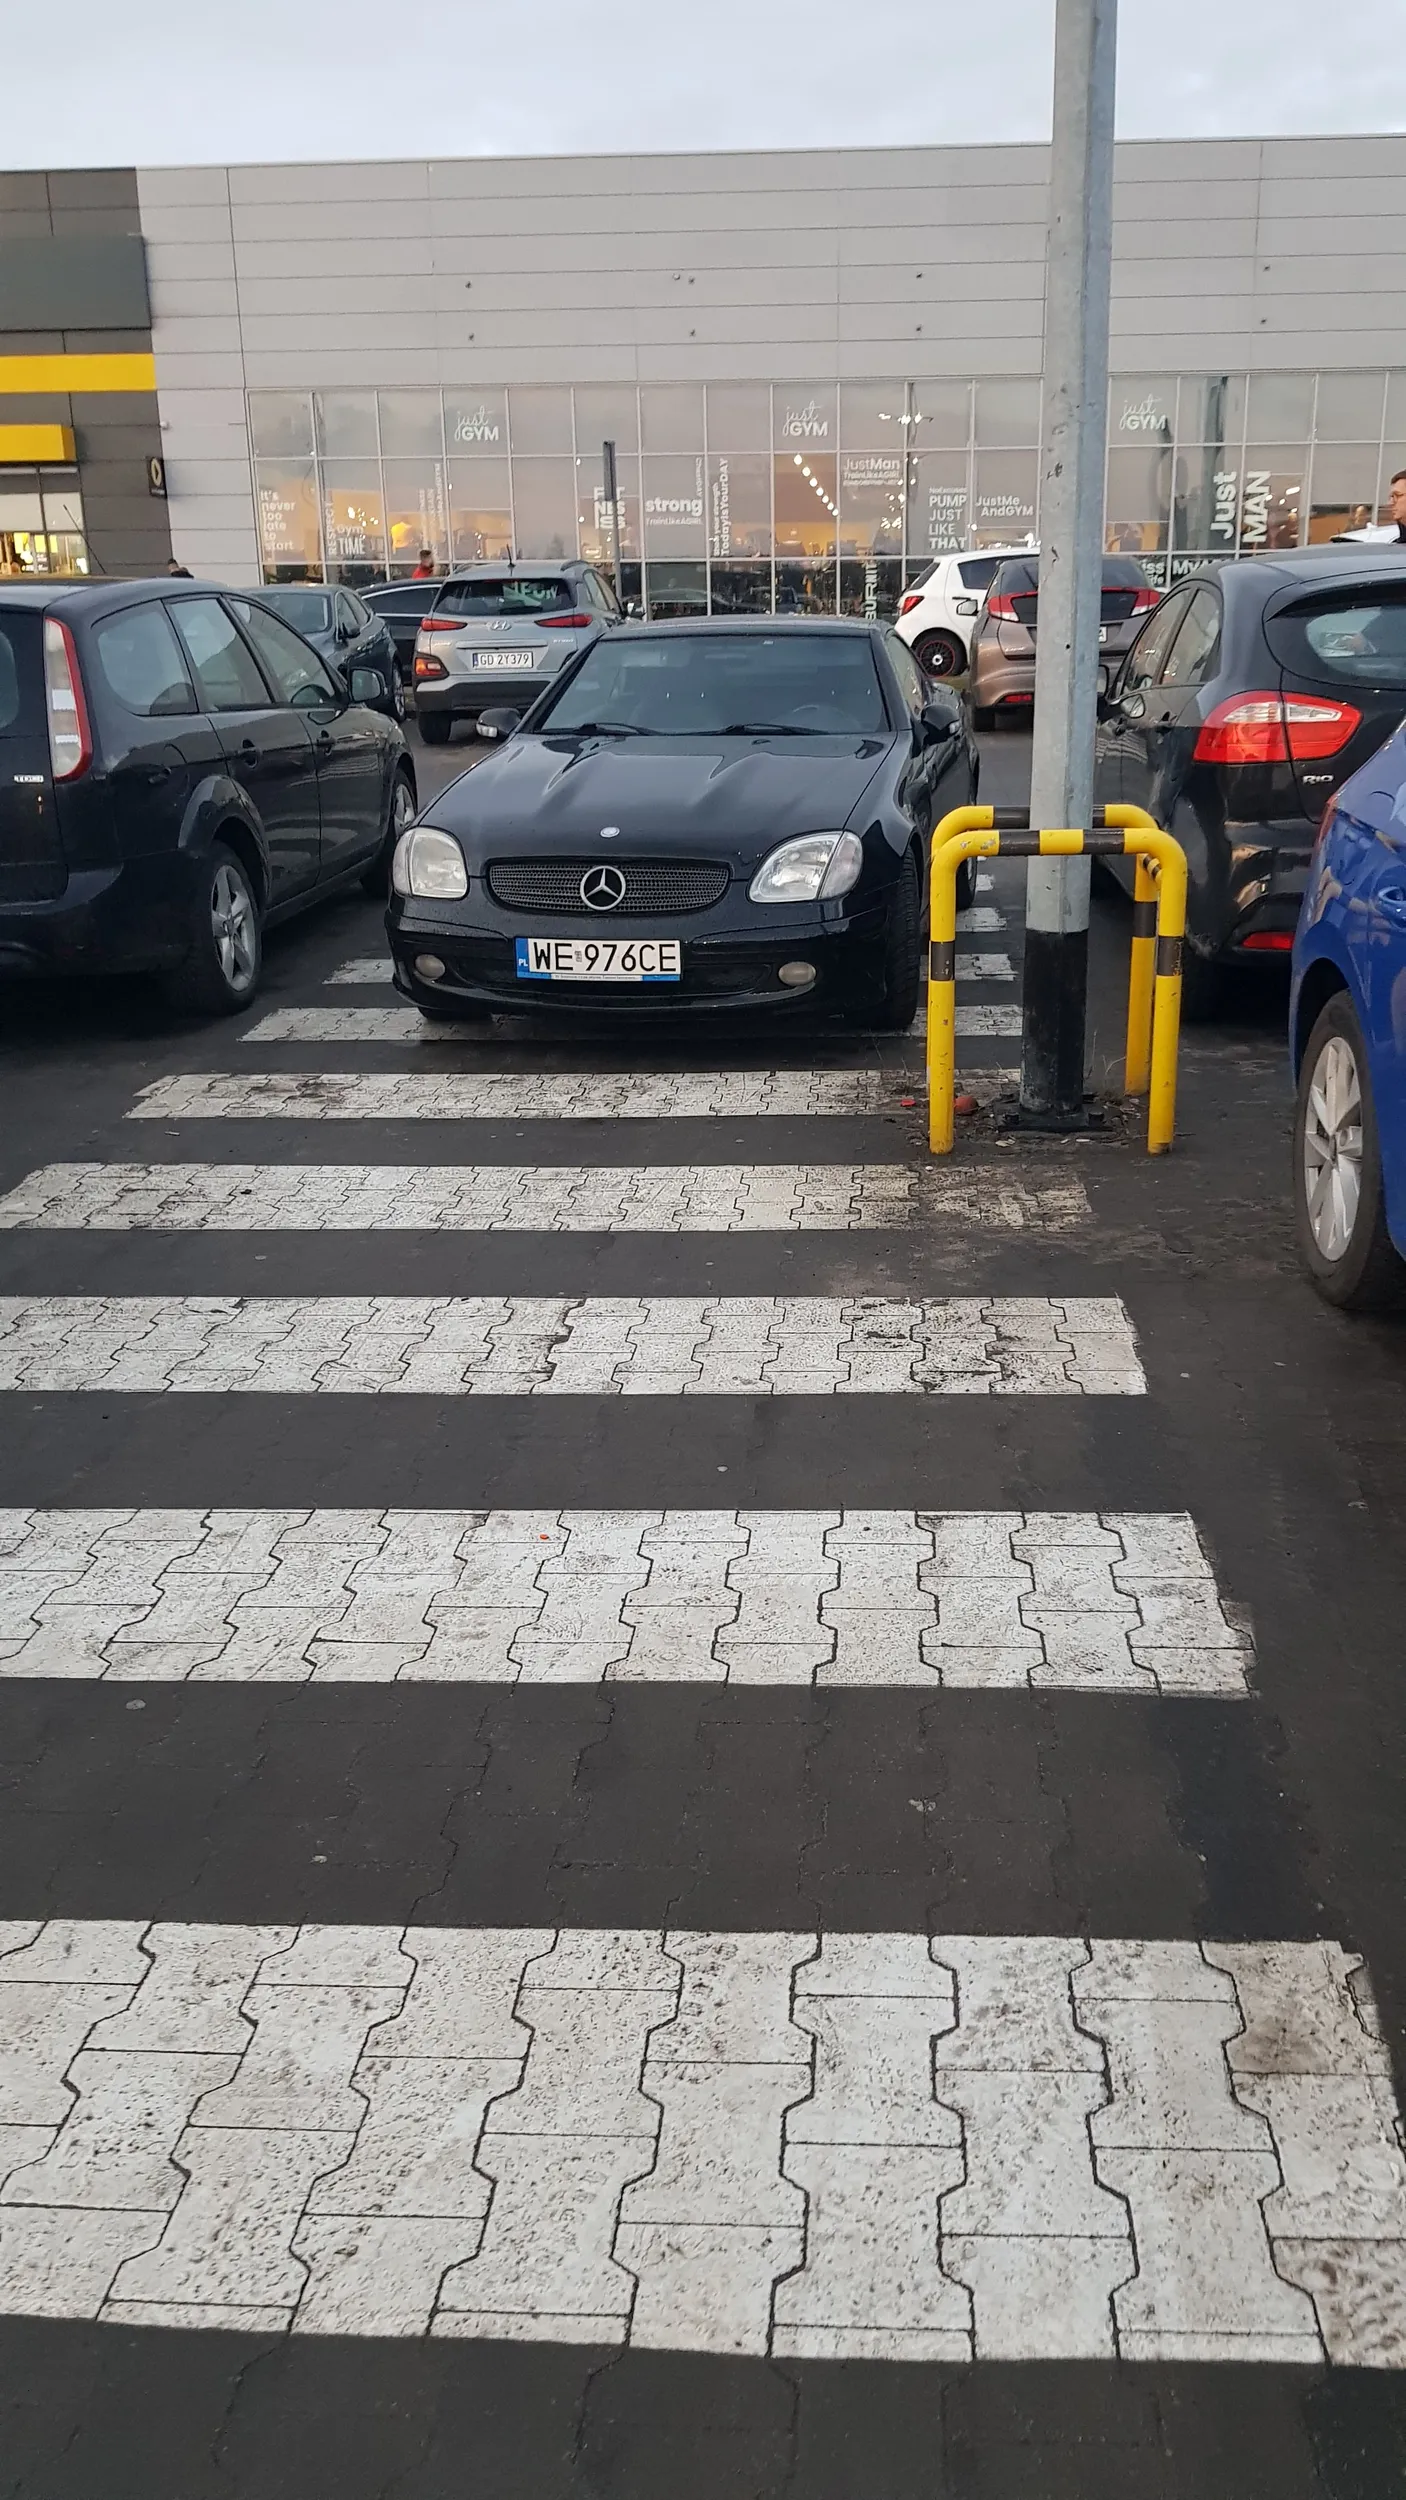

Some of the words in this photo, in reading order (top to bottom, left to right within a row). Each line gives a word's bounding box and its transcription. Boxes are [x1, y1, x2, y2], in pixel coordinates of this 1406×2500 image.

[783, 400, 823, 436] just
[1119, 393, 1162, 430] just
[455, 405, 494, 441] just
[1127, 414, 1166, 430] GYM
[462, 425, 499, 441] GYM
[789, 421, 828, 437] GYM
[844, 457, 900, 470] JustMan
[261, 501, 296, 511] never
[645, 497, 703, 517] strong
[929, 494, 967, 507] PUMP
[975, 495, 1021, 507] JustMe
[1242, 470, 1271, 543] MAN
[929, 509, 963, 521] JUST
[981, 505, 1034, 517] AndGYM
[929, 523, 956, 535] LIKE
[338, 537, 366, 555] TIME
[929, 536, 967, 549] THAT
[480, 653, 494, 665] GD
[497, 654, 529, 665] 2Y379
[1303, 774, 1334, 785] RIO
[518, 958, 528, 967] PL
[533, 942, 573, 971] WE
[584, 944, 676, 972] 976CE
